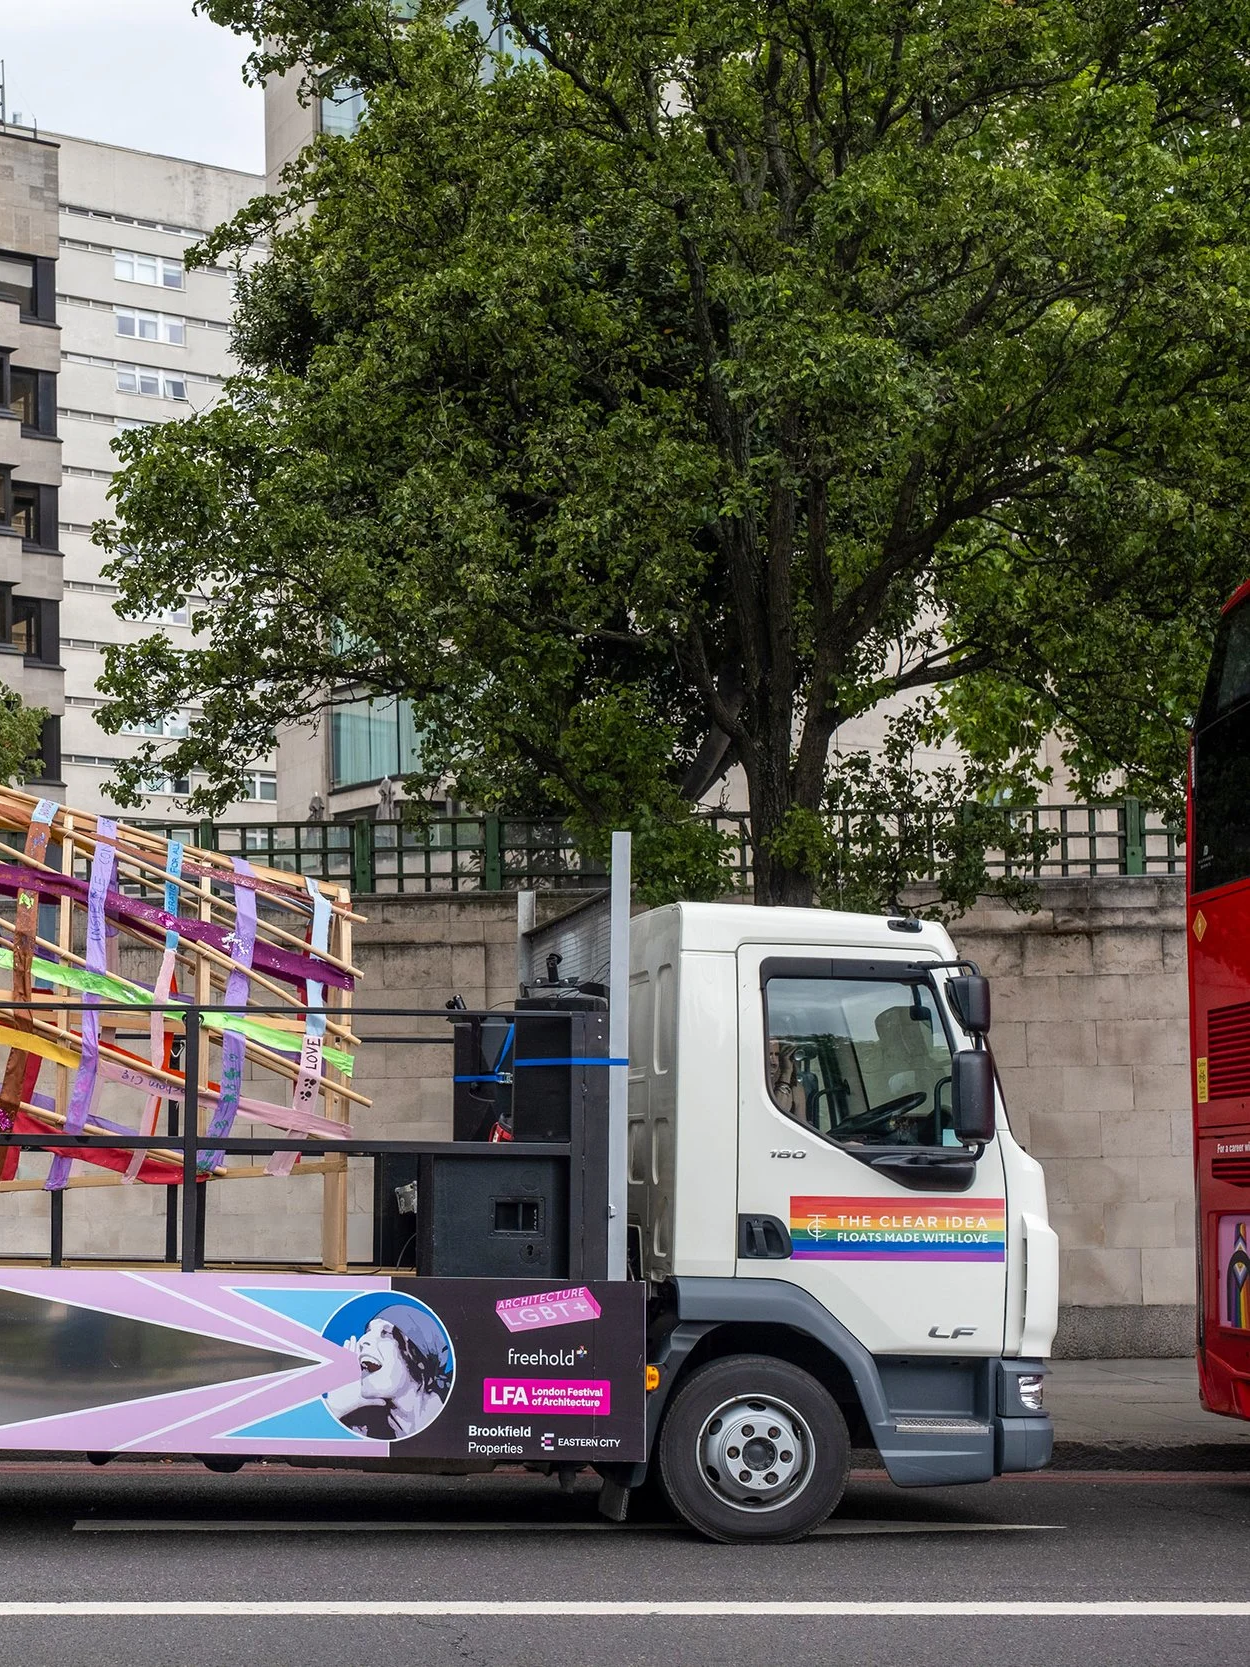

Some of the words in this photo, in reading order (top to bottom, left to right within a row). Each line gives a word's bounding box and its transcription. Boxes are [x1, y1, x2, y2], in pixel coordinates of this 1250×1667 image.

[303, 1037, 323, 1070] LOVE
[837, 1215, 872, 1228] THE
[879, 1215, 938, 1228] CLEAR
[945, 1216, 988, 1229] IDEA
[837, 1232, 882, 1243] FLOATS
[884, 1232, 920, 1243] MADE
[921, 1233, 955, 1243] WITH
[957, 1233, 989, 1244] LOVE
[497, 1287, 585, 1311] ARCHITECTURE
[502, 1301, 588, 1327] LGBT+
[927, 1326, 978, 1339] LF
[508, 1348, 575, 1366] freehold
[490, 1386, 529, 1406] LFA
[531, 1387, 566, 1397] London
[567, 1387, 603, 1397] Festival
[531, 1397, 542, 1407] of
[543, 1397, 600, 1407] Architecture
[468, 1425, 531, 1438] Brookfield
[468, 1442, 523, 1455] Properties
[558, 1438, 598, 1447] EASTERN
[599, 1438, 621, 1448] CITY
